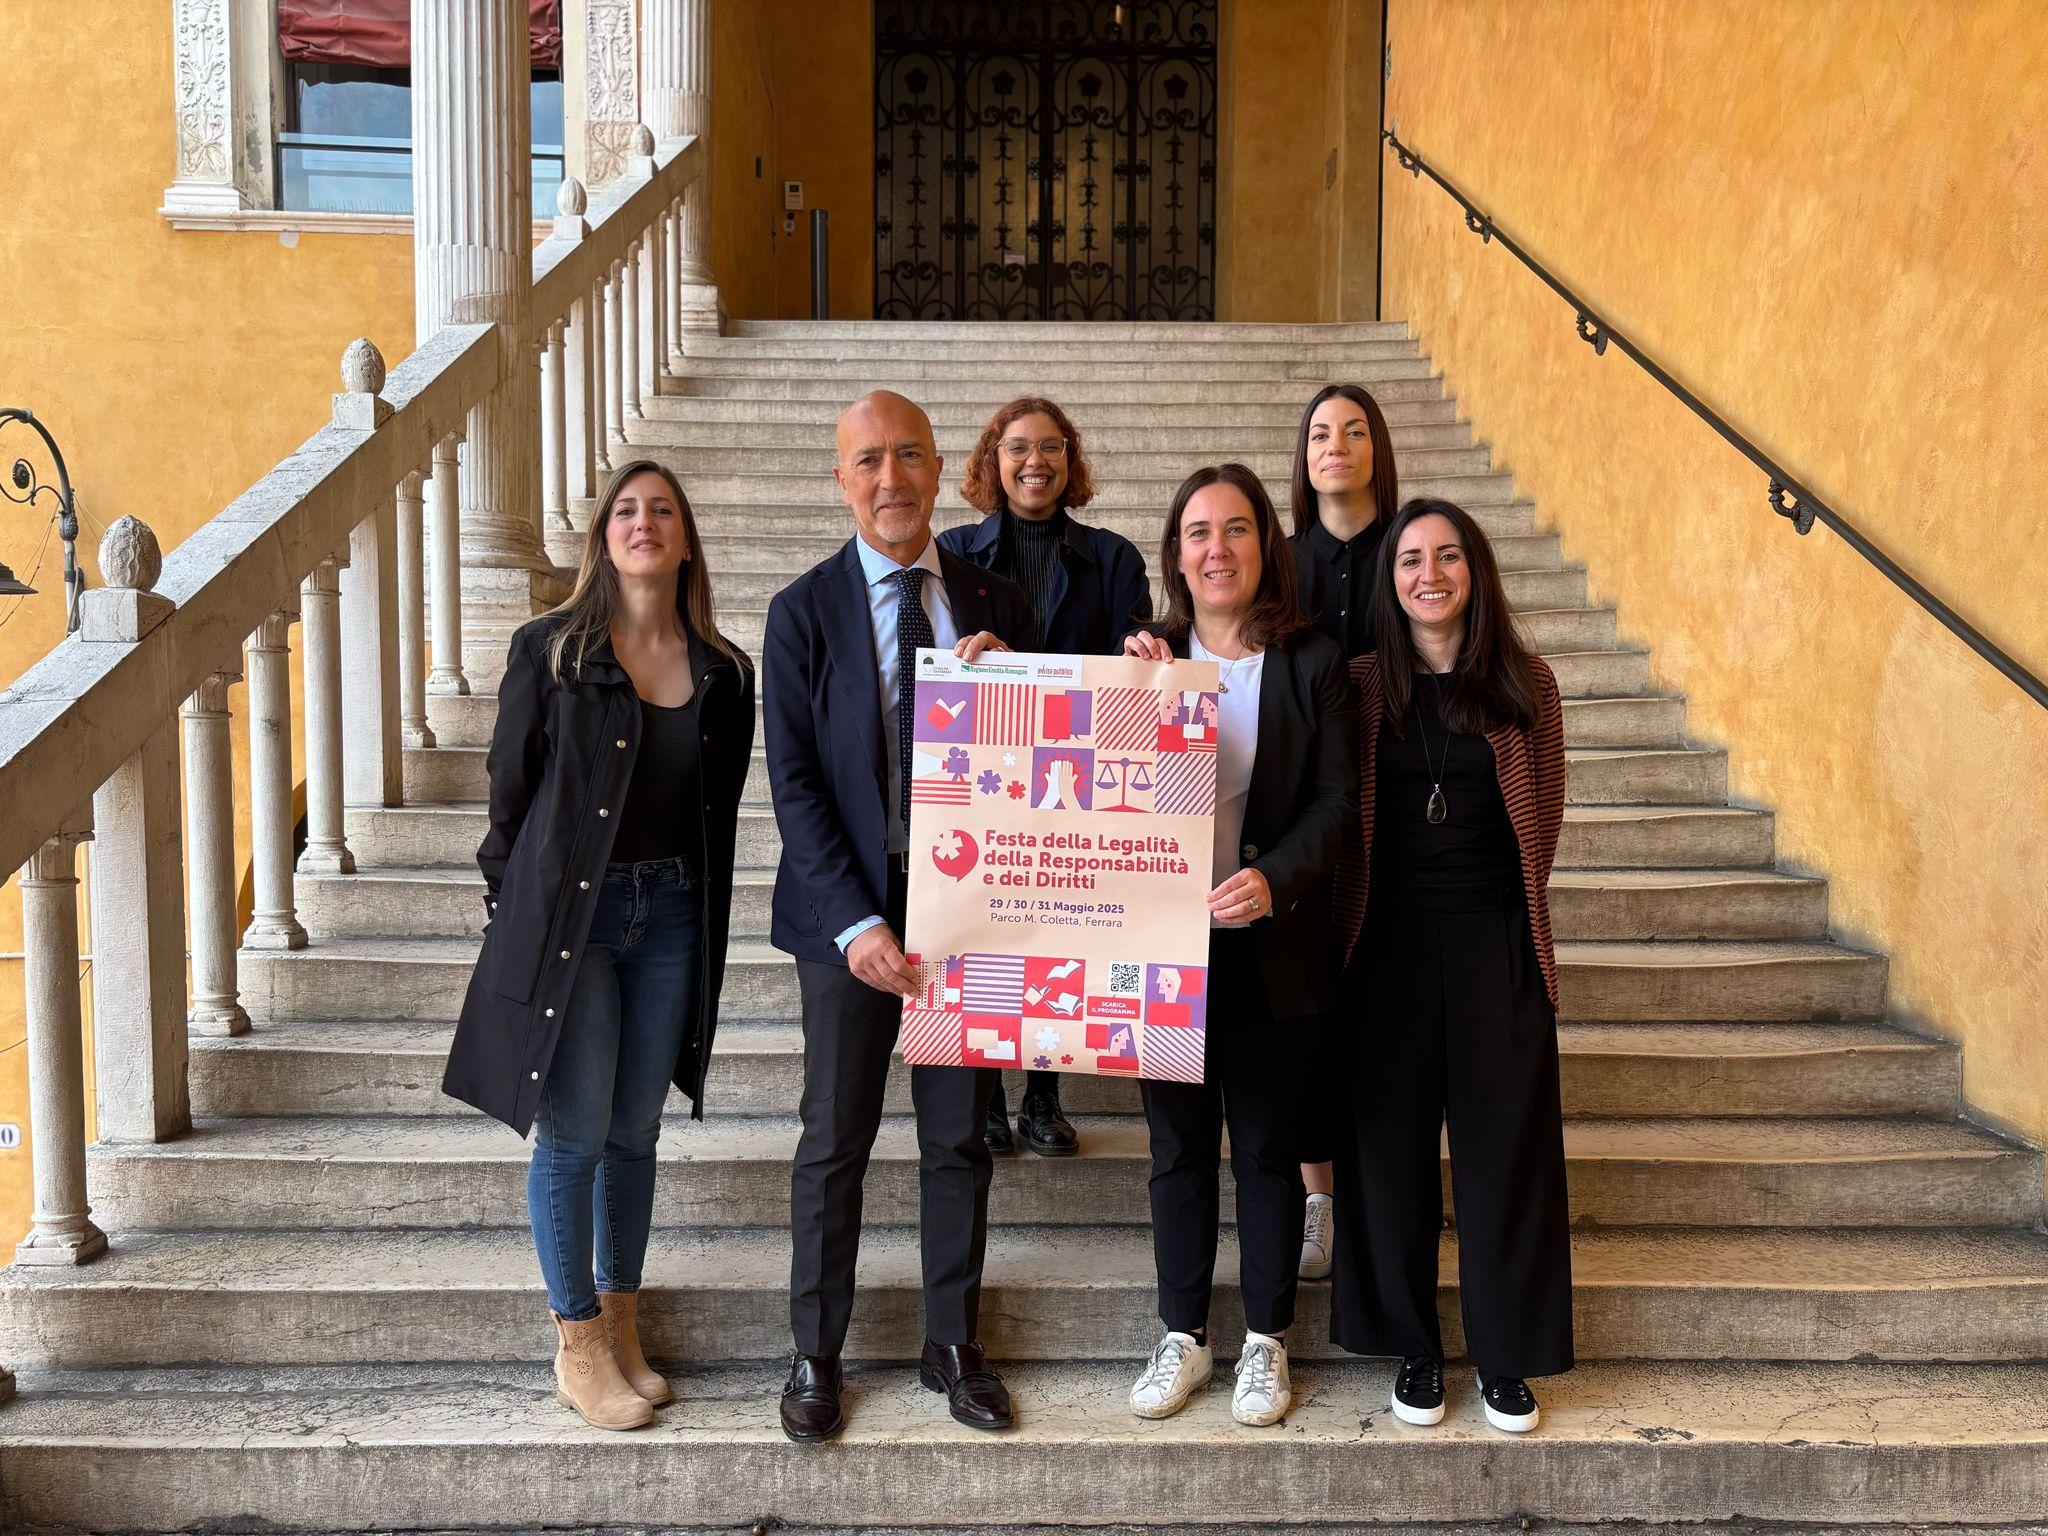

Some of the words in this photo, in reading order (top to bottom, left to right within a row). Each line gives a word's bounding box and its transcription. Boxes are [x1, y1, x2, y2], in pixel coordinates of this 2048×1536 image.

[985, 829, 1037, 848] Festa
[1042, 832, 1092, 850] della
[1098, 834, 1179, 856] Legalità
[983, 850, 1033, 867] della
[1039, 852, 1189, 875] Responsabilità
[982, 874, 994, 886] e
[999, 869, 1030, 887] dei
[1036, 871, 1096, 890] Diritti
[989, 898, 1003, 908] 29
[1005, 899, 1011, 910] /
[1013, 899, 1028, 910] 30
[1030, 900, 1036, 910] /
[1038, 900, 1051, 910] 31
[1053, 901, 1095, 914] Maggio
[1097, 903, 1125, 914] 2025
[990, 913, 1021, 924] Parco
[1024, 914, 1037, 924] M.
[1040, 915, 1082, 927] Coletta,
[1085, 917, 1123, 928] Ferrara
